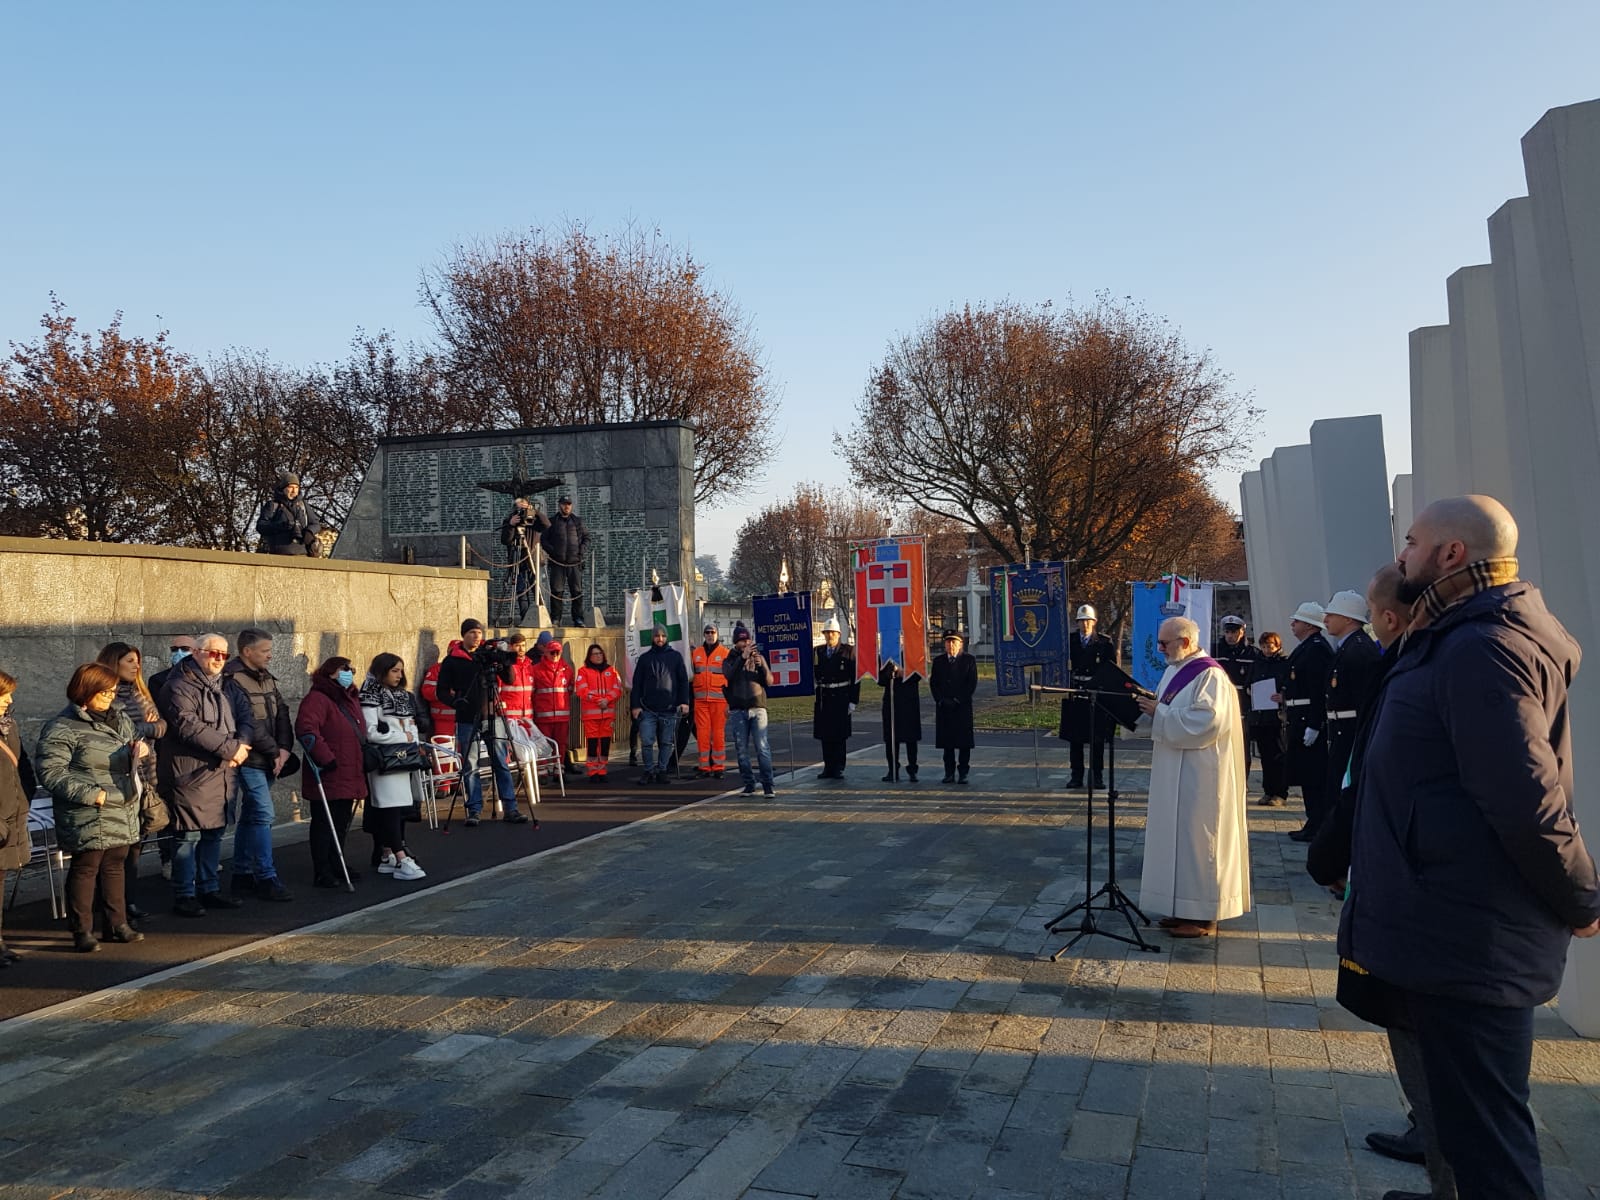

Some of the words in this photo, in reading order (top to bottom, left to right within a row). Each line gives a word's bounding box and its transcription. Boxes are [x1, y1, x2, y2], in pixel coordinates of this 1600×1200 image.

[758, 622, 807, 633] METROPOLITANA
[768, 634, 775, 643] DI
[776, 633, 798, 642] TORINO
